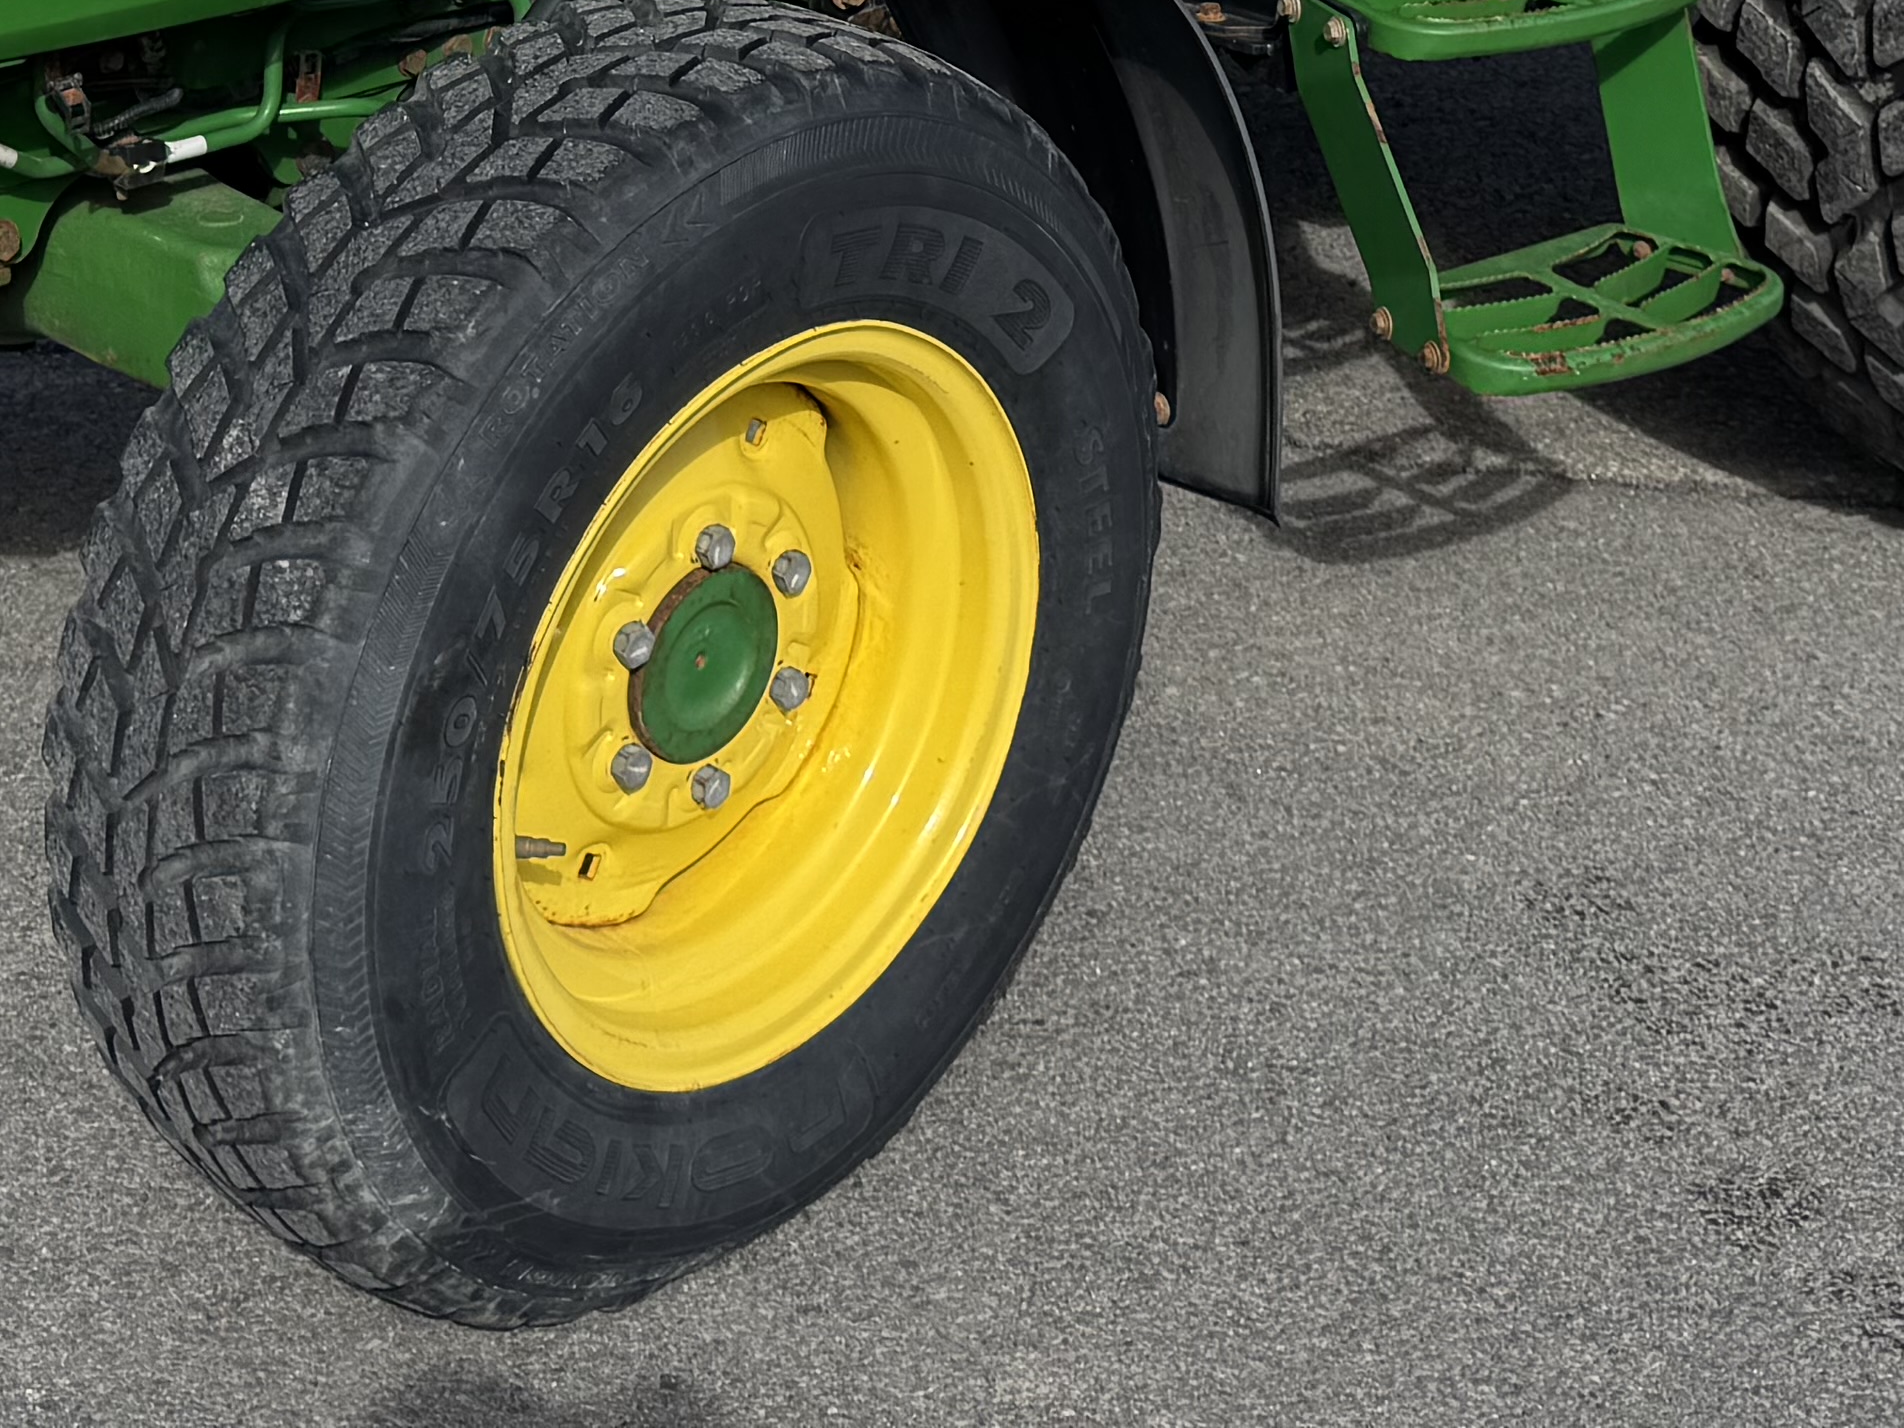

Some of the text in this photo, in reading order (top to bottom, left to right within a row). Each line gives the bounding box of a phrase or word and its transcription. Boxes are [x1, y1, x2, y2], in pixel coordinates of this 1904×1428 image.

[830, 221, 1052, 352] TRI 2
[1073, 418, 1114, 616] STEEL
